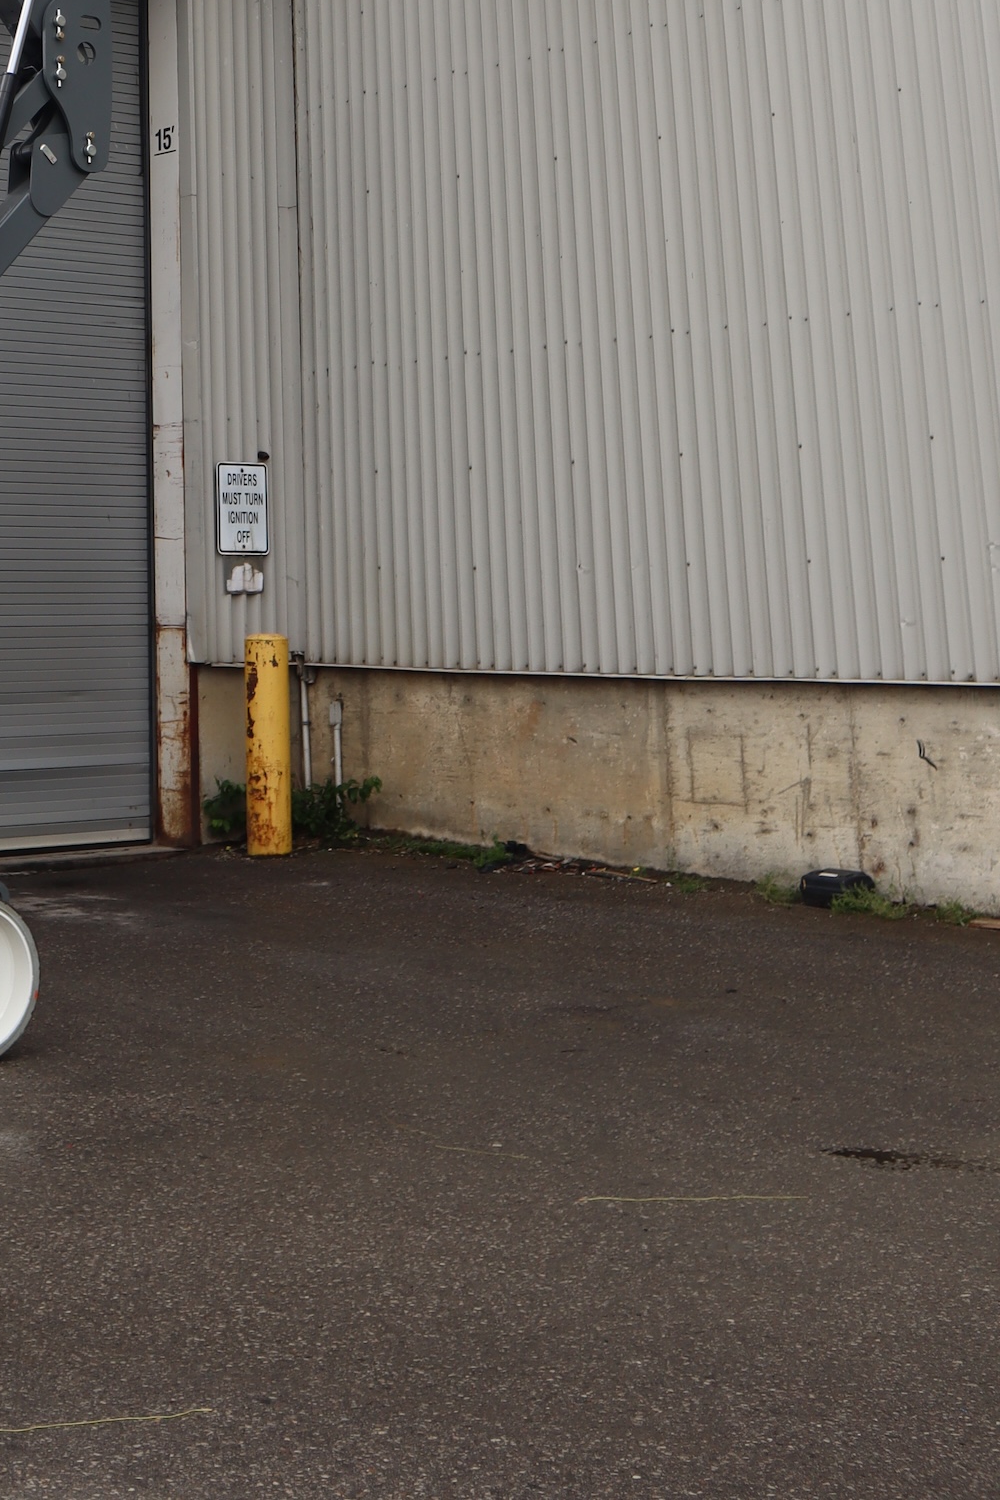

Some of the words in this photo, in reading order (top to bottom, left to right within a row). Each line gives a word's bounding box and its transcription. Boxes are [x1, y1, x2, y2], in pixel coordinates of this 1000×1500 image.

[227, 473, 258, 487] DRIVERS
[222, 492, 242, 505] MUST
[244, 492, 264, 506] TURN
[227, 511, 259, 525] IGNITION
[236, 530, 251, 543] OFF
